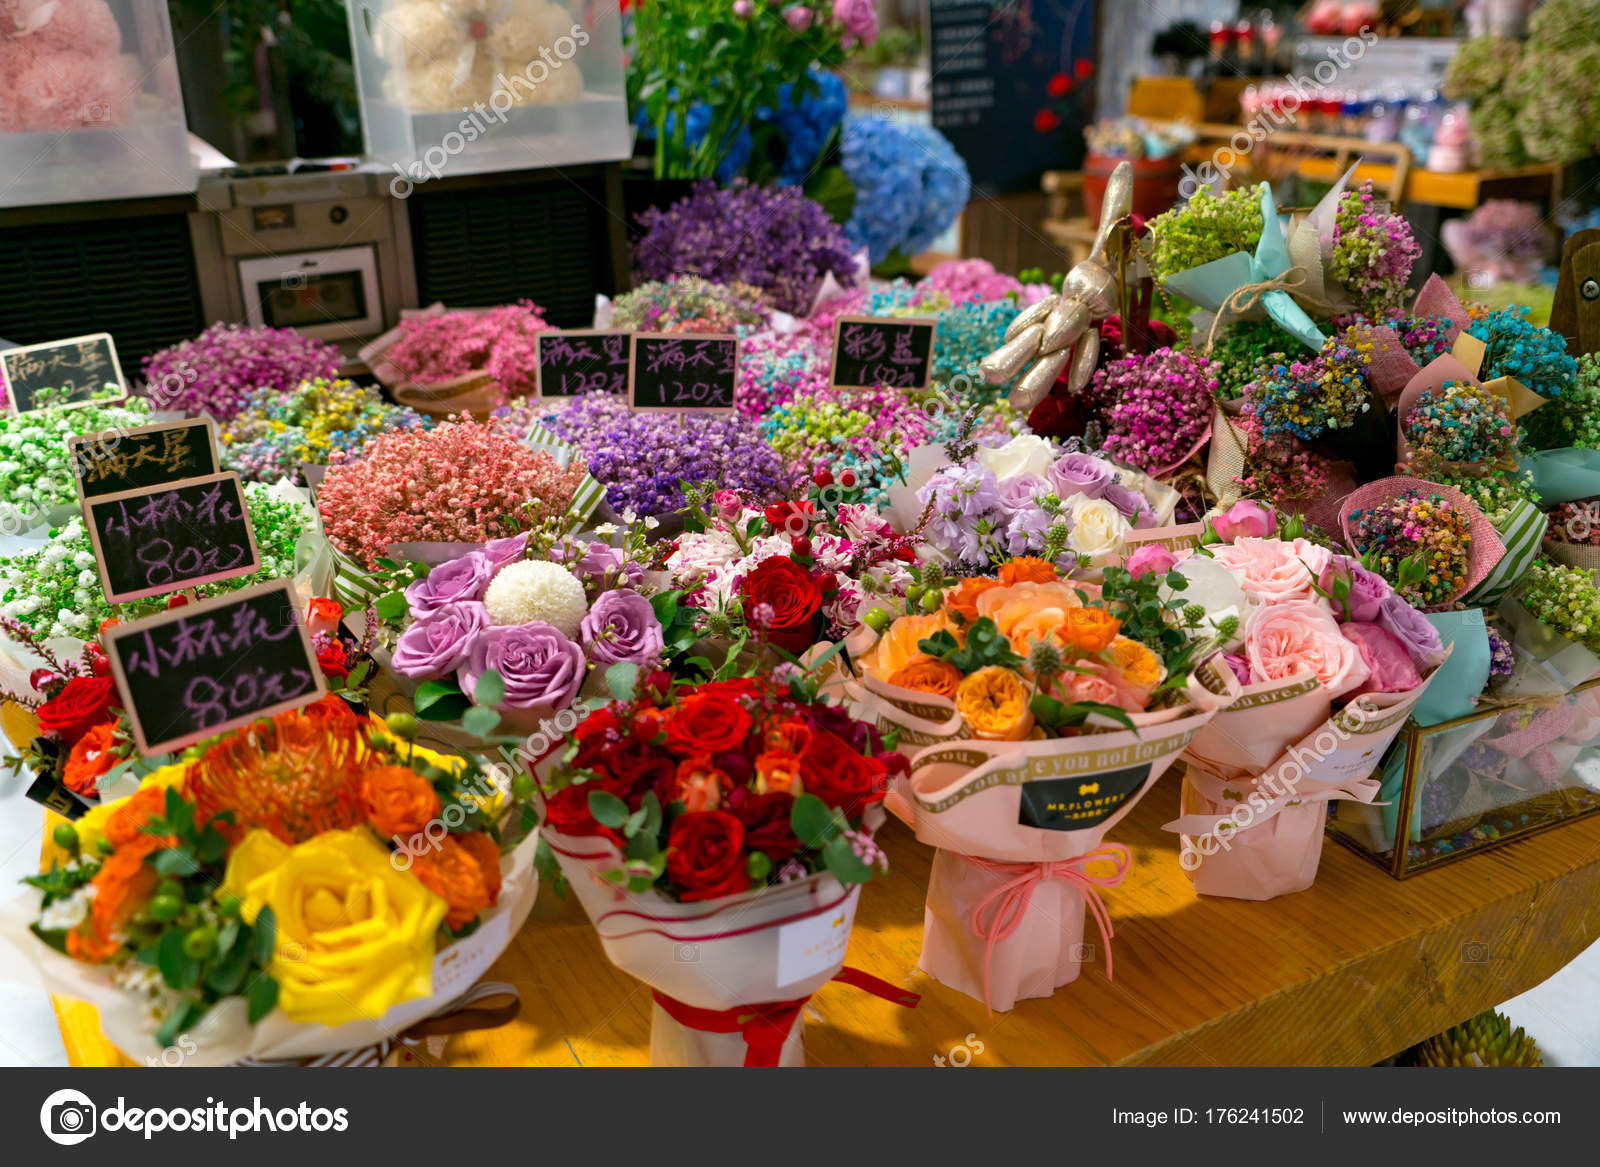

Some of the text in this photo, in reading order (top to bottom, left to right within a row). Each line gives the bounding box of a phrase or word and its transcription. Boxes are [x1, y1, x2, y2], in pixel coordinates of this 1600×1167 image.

[659, 382, 733, 405] 120元
[105, 481, 244, 537] 小杯花
[136, 537, 245, 586] 80元
[128, 602, 298, 678] 小杯花
[184, 667, 311, 729] 80元
[1051, 755, 1090, 777] you
[1096, 747, 1129, 766] not
[1135, 741, 1165, 761] for
